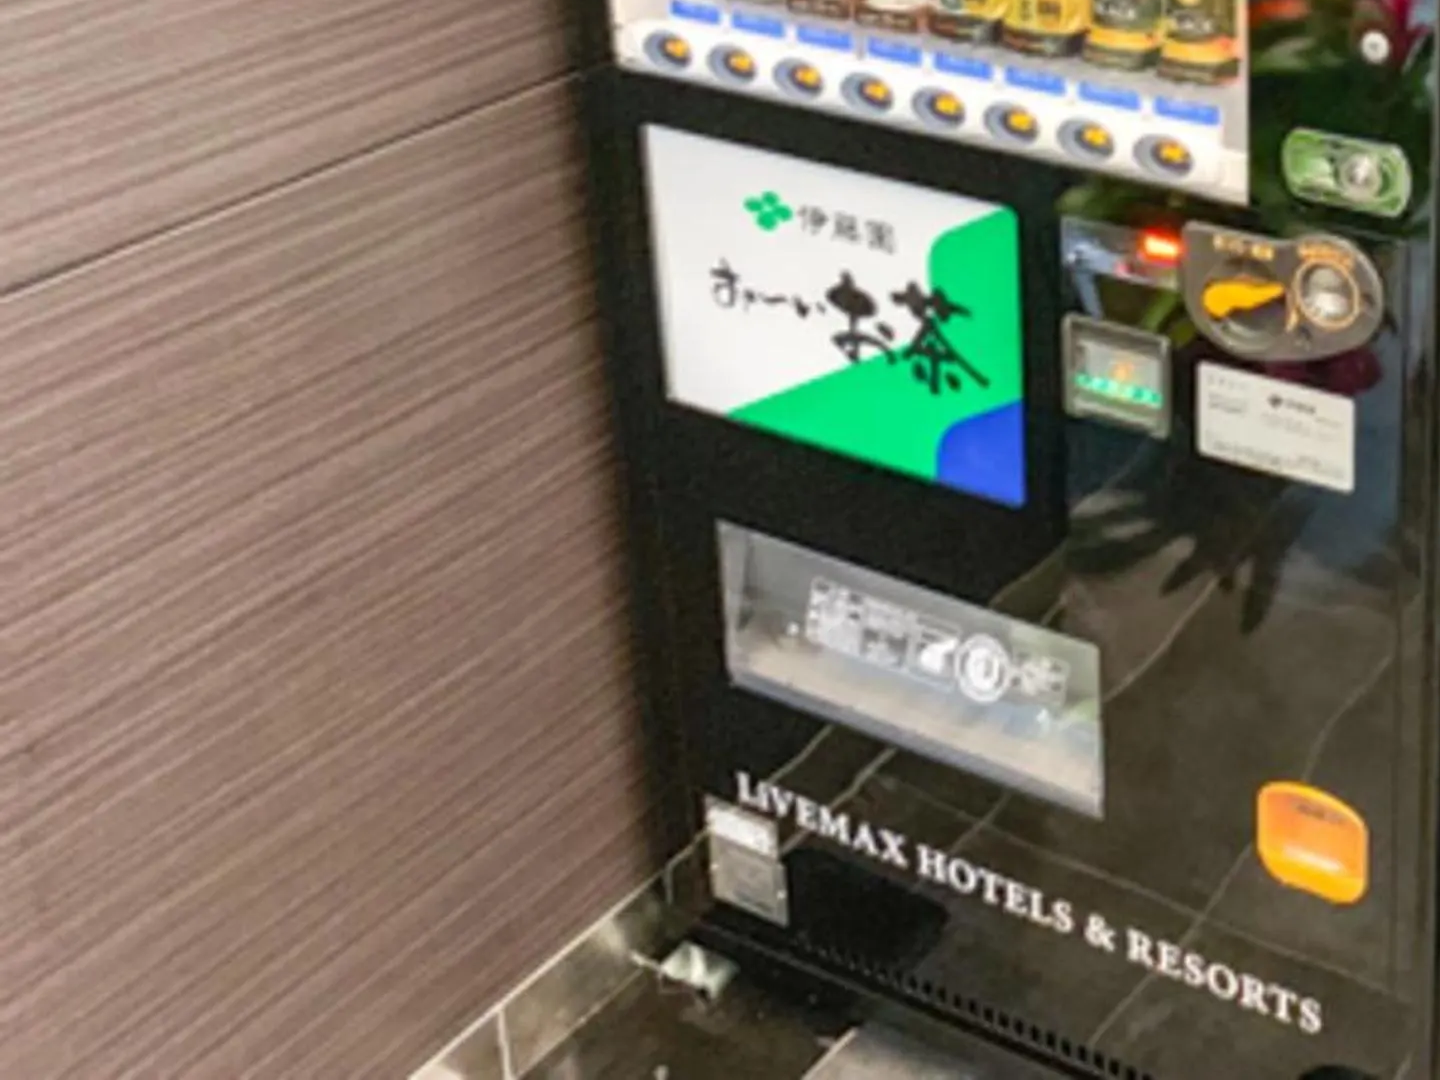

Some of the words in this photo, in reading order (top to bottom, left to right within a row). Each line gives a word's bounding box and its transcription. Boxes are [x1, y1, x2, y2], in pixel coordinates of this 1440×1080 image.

[916, 844, 1076, 934] HOTELS
[1084, 913, 1116, 953] &
[1125, 927, 1323, 1035] RESORTS
